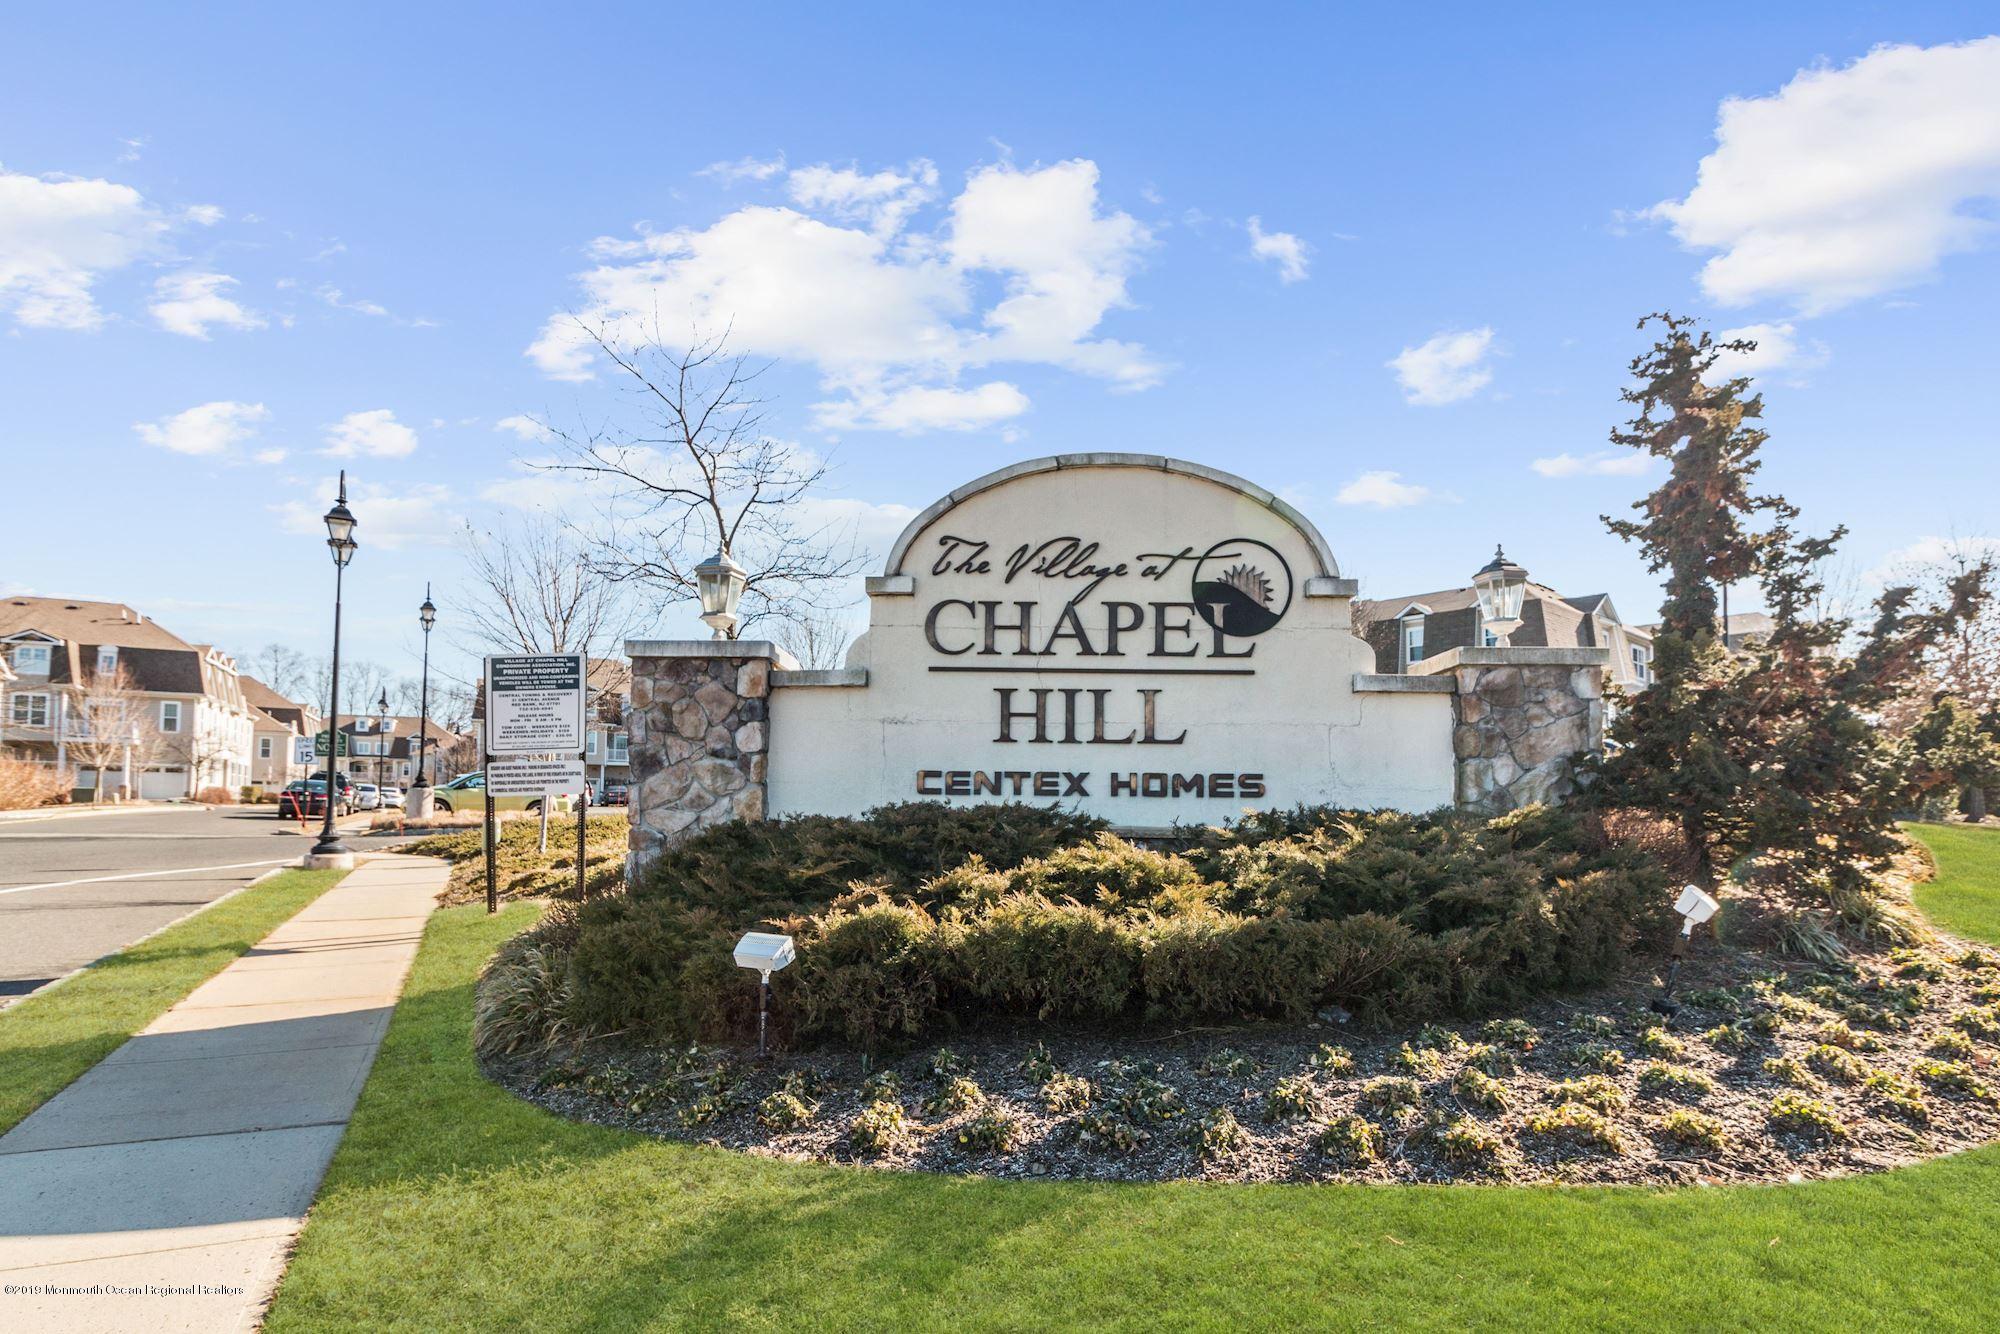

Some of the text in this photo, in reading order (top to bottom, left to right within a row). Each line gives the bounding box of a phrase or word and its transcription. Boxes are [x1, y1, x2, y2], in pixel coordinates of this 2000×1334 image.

[932, 535, 1241, 605] The Village at
[925, 600, 1256, 657] CHAPEL
[993, 688, 1186, 744] HILL
[300, 751, 313, 762] 15
[917, 770, 1265, 798] CENTEX HOMES
